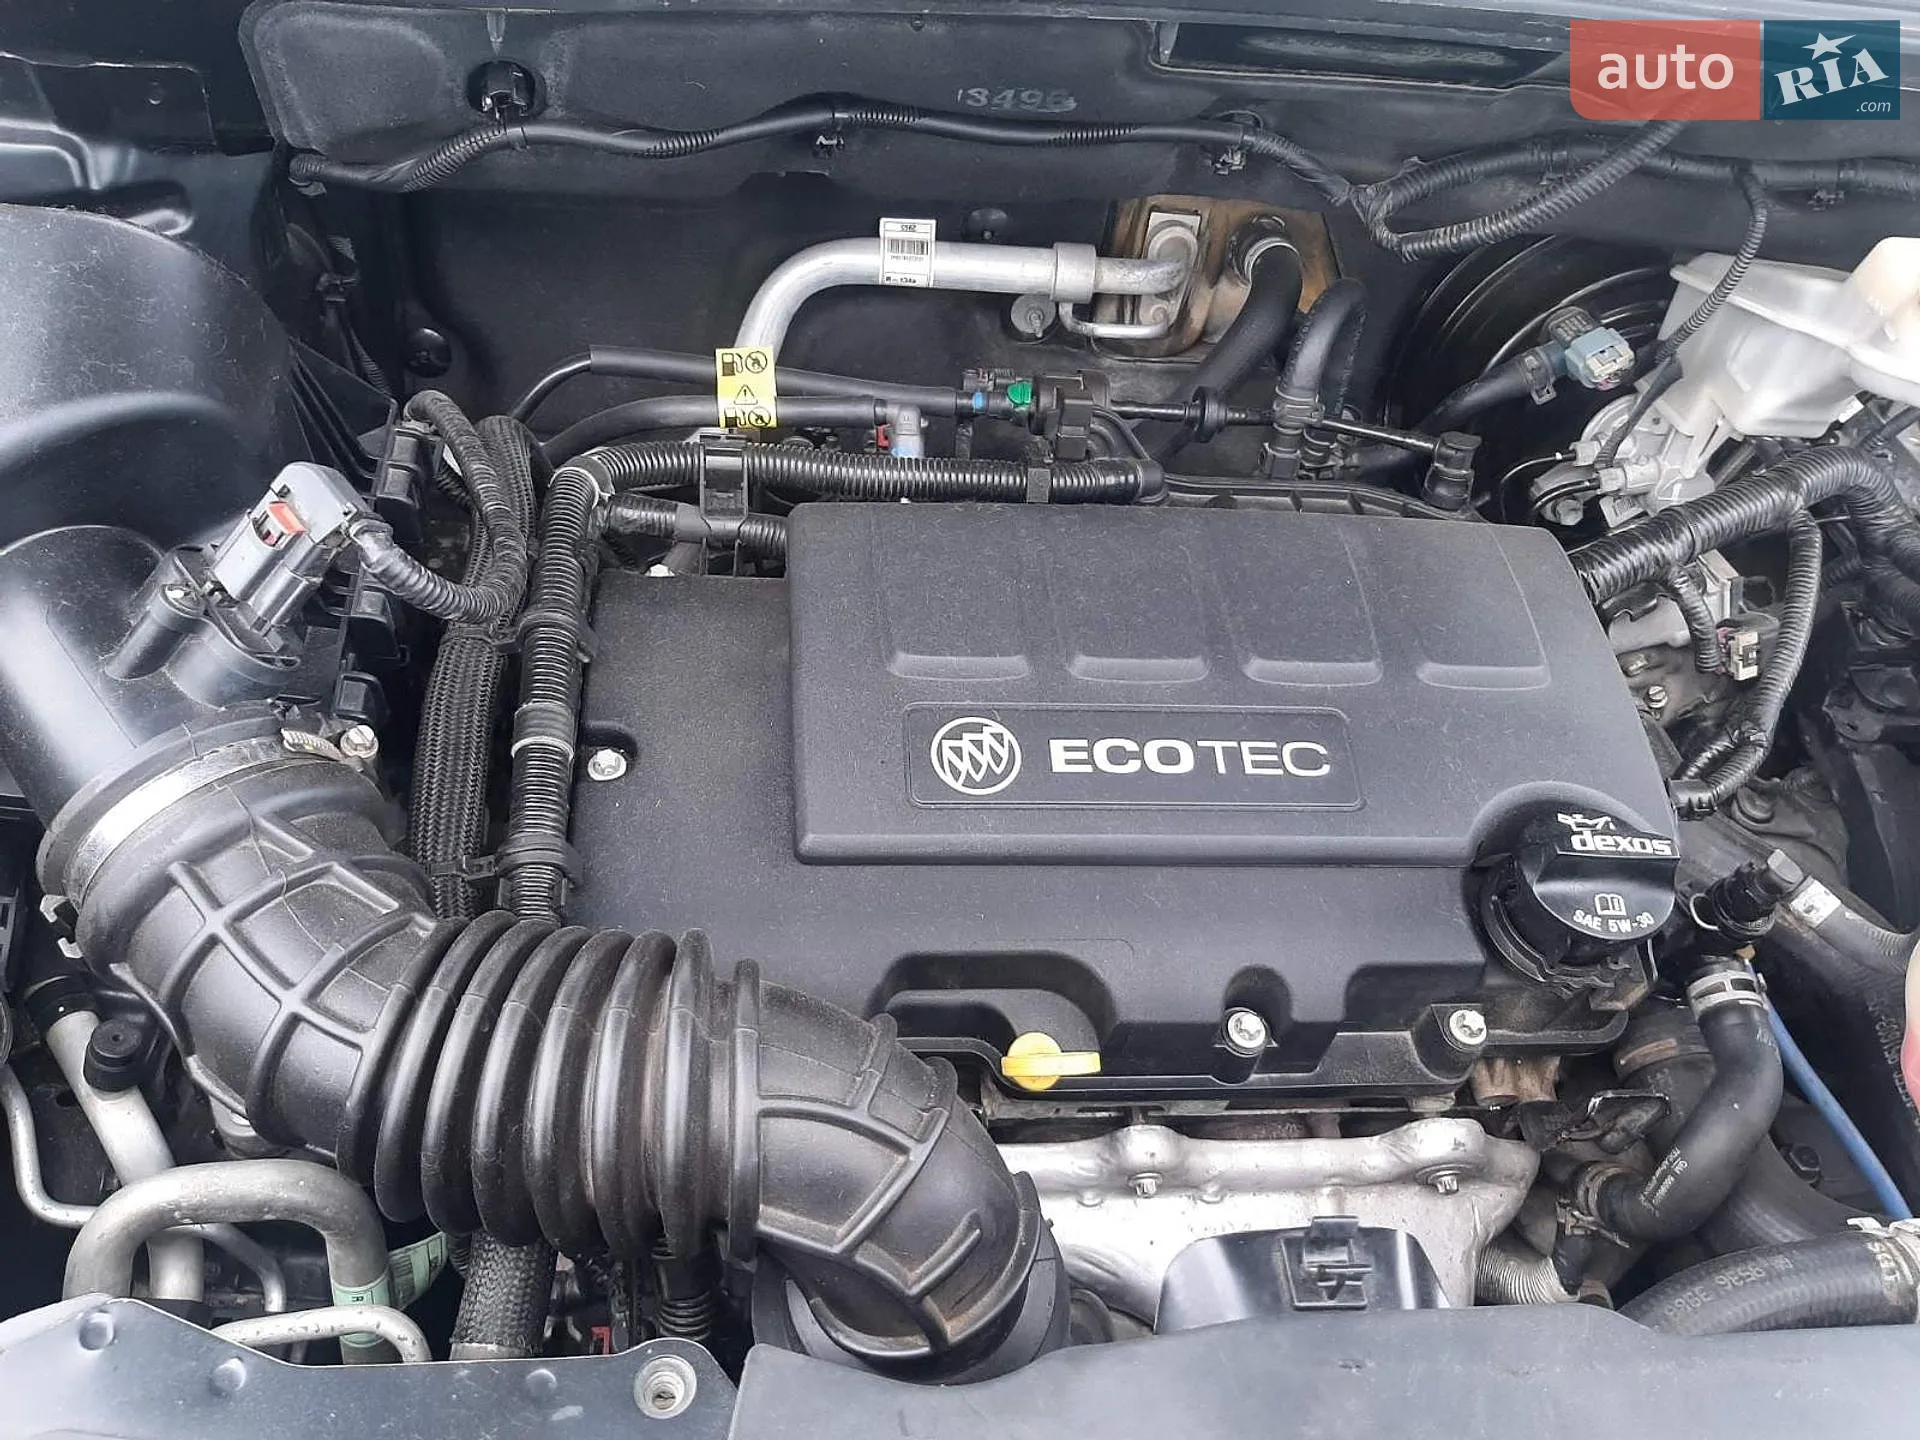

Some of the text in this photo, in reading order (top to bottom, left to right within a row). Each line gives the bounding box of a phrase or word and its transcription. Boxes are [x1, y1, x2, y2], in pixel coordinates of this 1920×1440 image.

[1049, 738, 1331, 777] ECOTEC
[1571, 830, 1672, 855] dexos
[1573, 909, 1655, 932] SAE 5W-30
